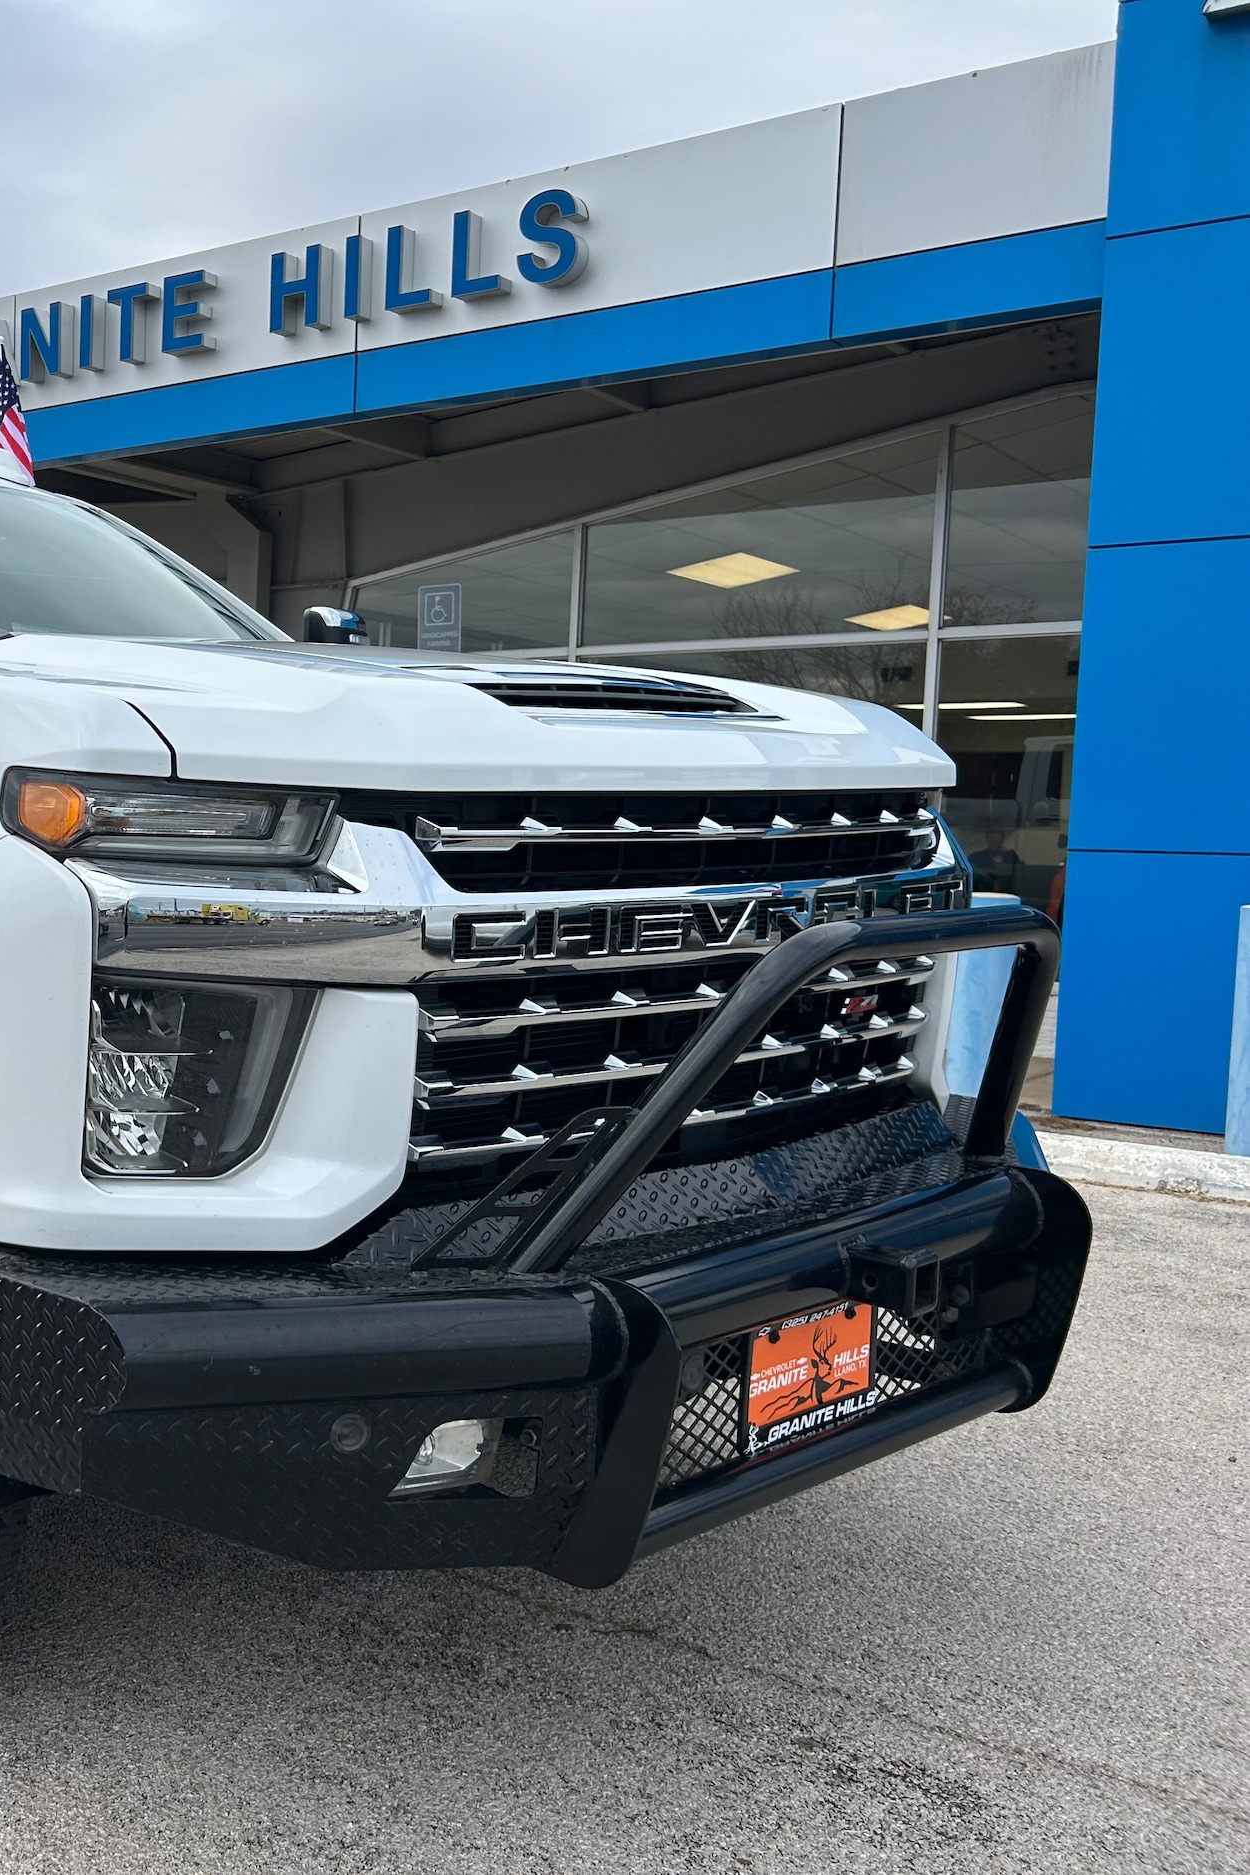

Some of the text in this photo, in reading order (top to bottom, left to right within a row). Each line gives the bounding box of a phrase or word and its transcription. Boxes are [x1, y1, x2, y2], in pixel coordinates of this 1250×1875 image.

[268, 188, 588, 338] HILLS
[420, 631, 459, 639] HANDICAPPED
[781, 1315, 809, 1330] (325)
[833, 1344, 870, 1369] HILLS
[760, 1359, 797, 1378] CHEVROLET
[833, 1359, 867, 1378] LLANO, TX
[749, 1365, 809, 1398] GRANITE
[767, 1390, 877, 1443] GRANITE HILLS
